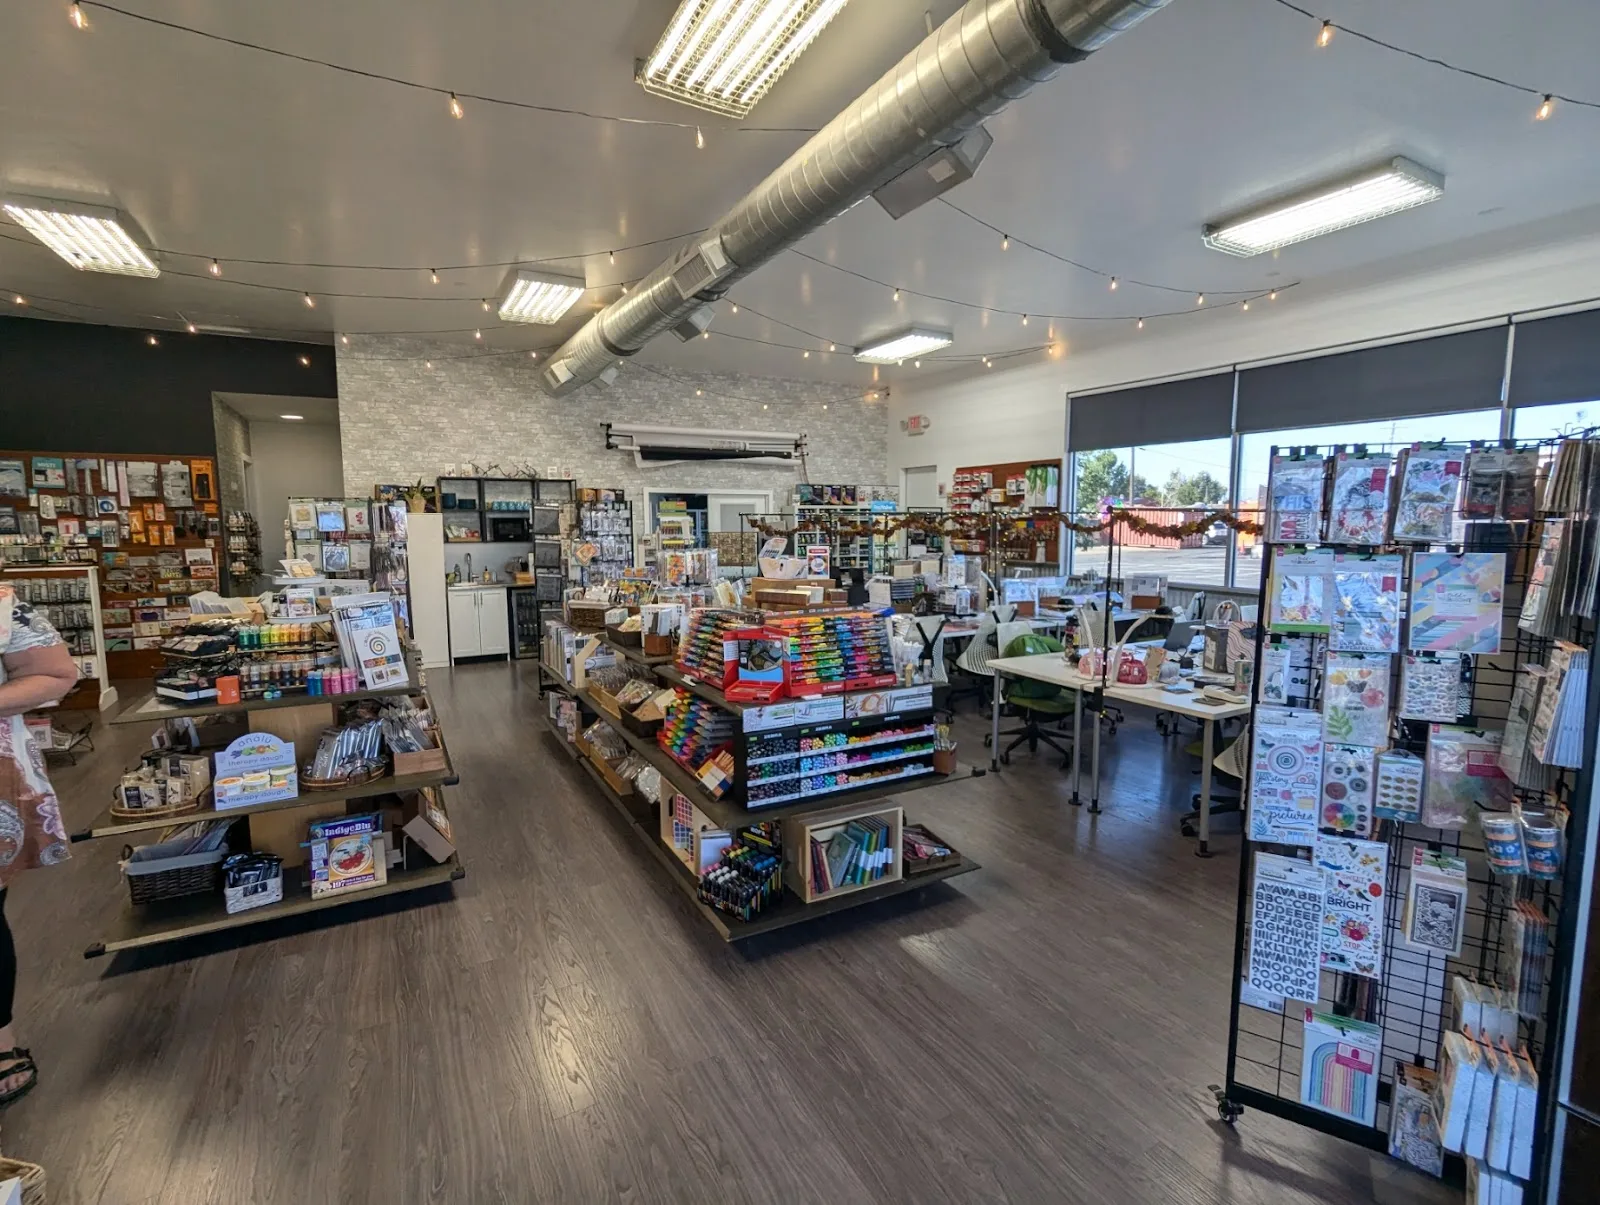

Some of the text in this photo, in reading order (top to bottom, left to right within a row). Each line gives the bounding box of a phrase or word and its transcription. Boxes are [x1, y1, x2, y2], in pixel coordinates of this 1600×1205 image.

[228, 759, 258, 767] therapy
[228, 788, 286, 803] therapy dough
[1268, 809, 1314, 824] pictures
[1327, 896, 1371, 912] BRIGHT
